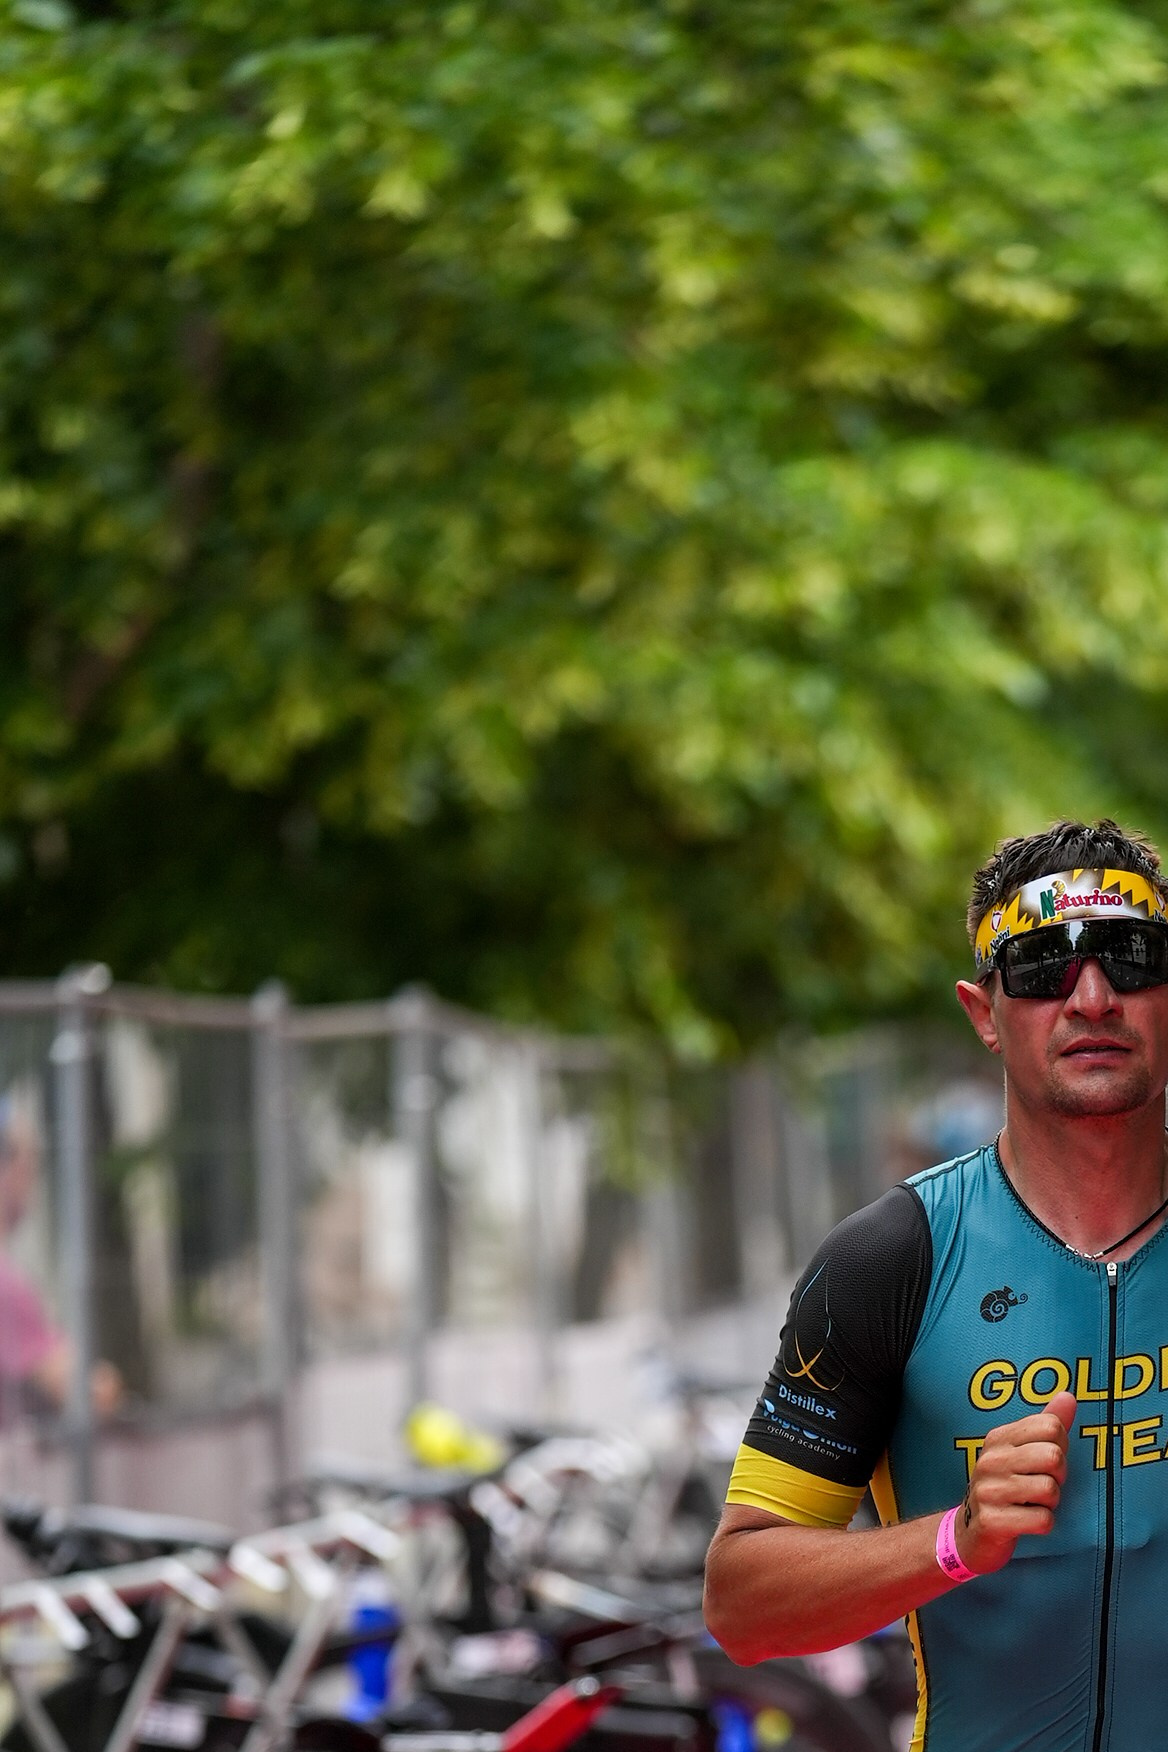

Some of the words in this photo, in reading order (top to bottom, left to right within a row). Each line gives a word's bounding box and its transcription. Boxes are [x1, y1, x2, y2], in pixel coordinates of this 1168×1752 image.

[1040, 889, 1123, 920] Naturino
[778, 1384, 837, 1420] Distillex
[767, 1424, 795, 1442] cycling
[797, 1436, 841, 1461] academy
